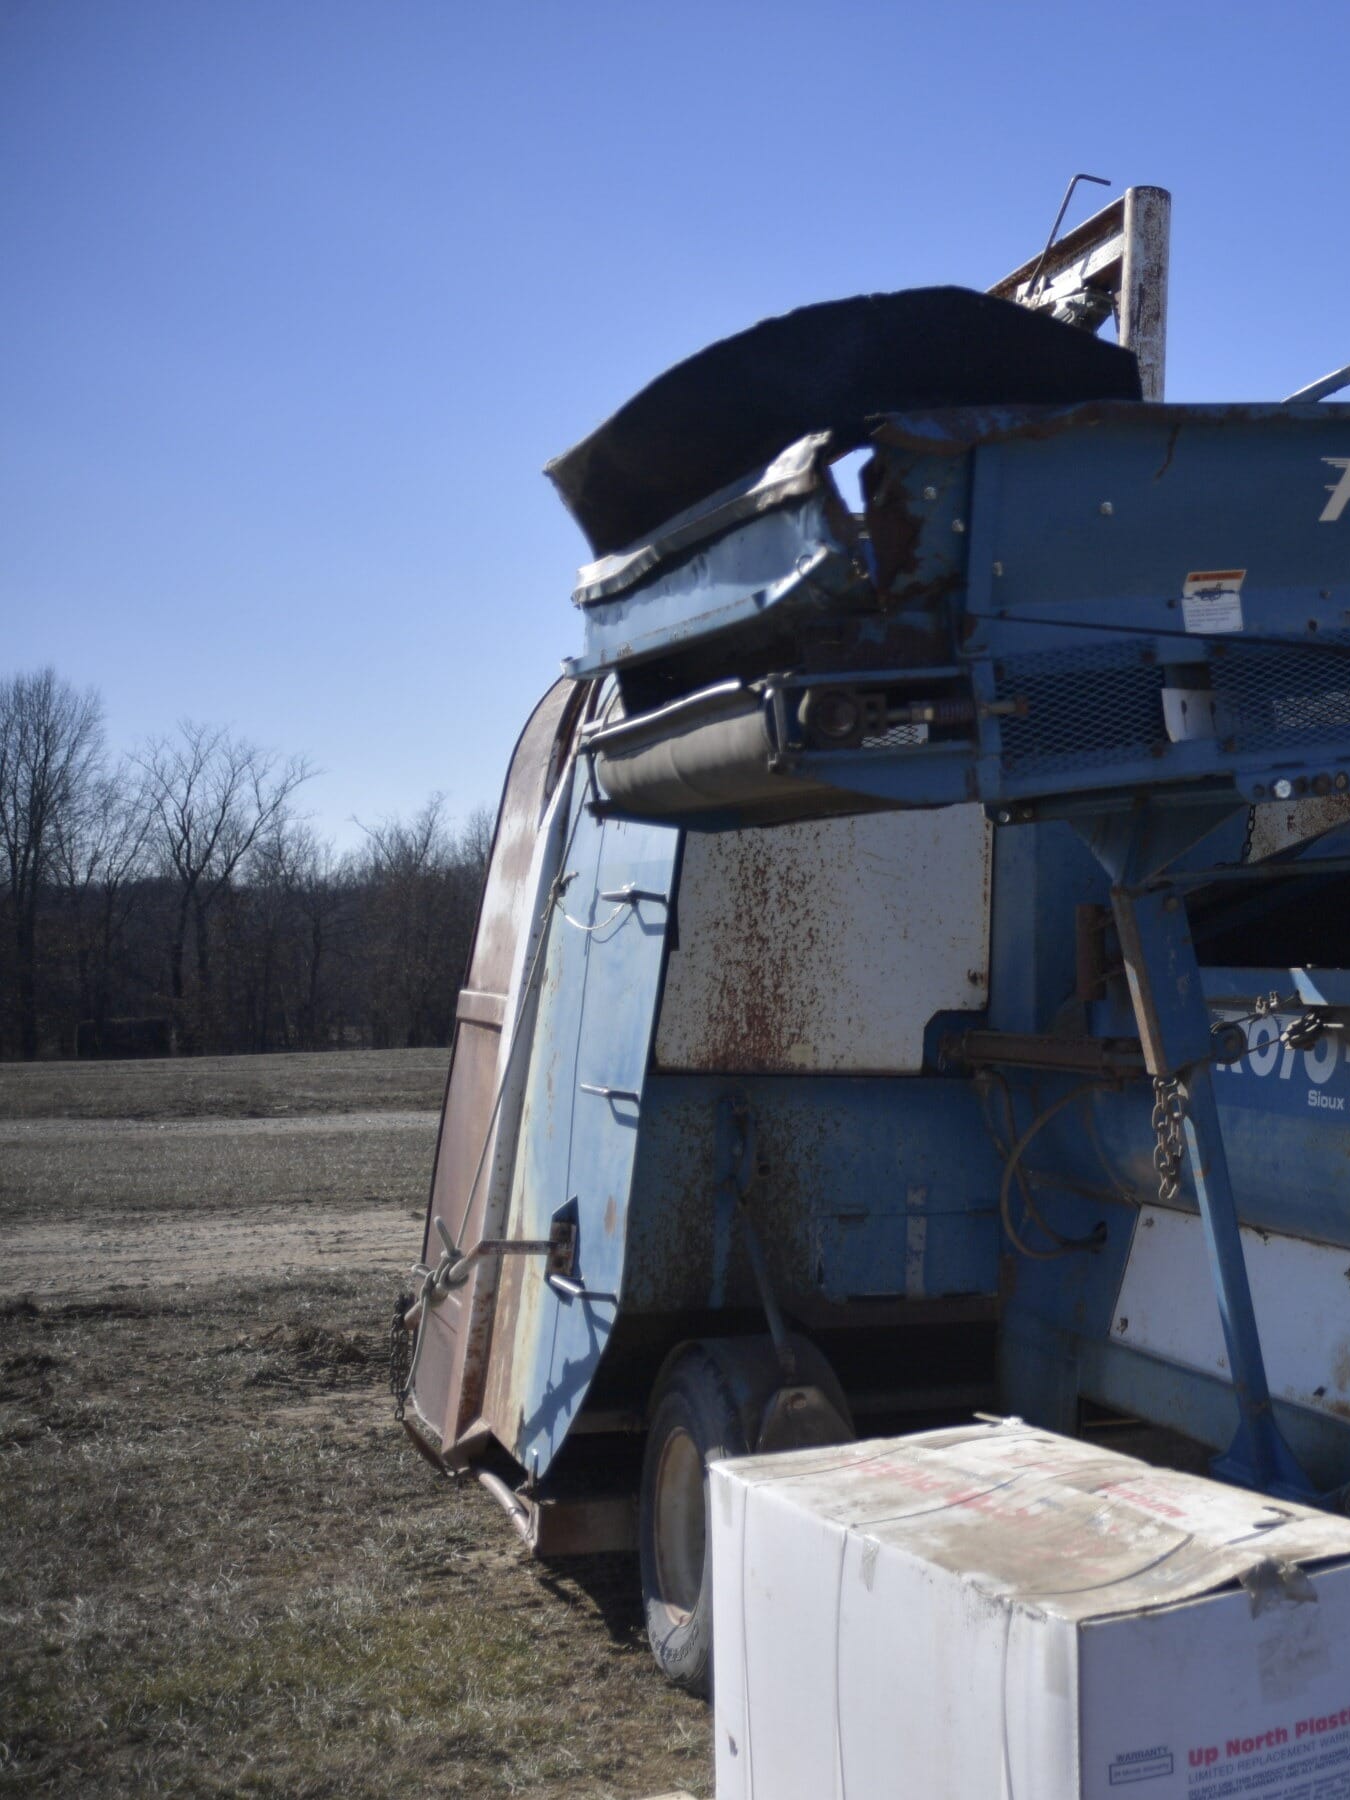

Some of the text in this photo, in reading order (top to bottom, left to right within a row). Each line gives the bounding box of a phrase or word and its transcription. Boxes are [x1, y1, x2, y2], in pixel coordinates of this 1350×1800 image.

[1307, 1089, 1345, 1111] Sioux
[1116, 1745, 1169, 1762] WARRANTY
[1187, 1746, 1220, 1768] Up
[1225, 1726, 1289, 1759] North
[1187, 1763, 1235, 1785] LIMITED
[1236, 1740, 1316, 1772] REPLACEMENT
